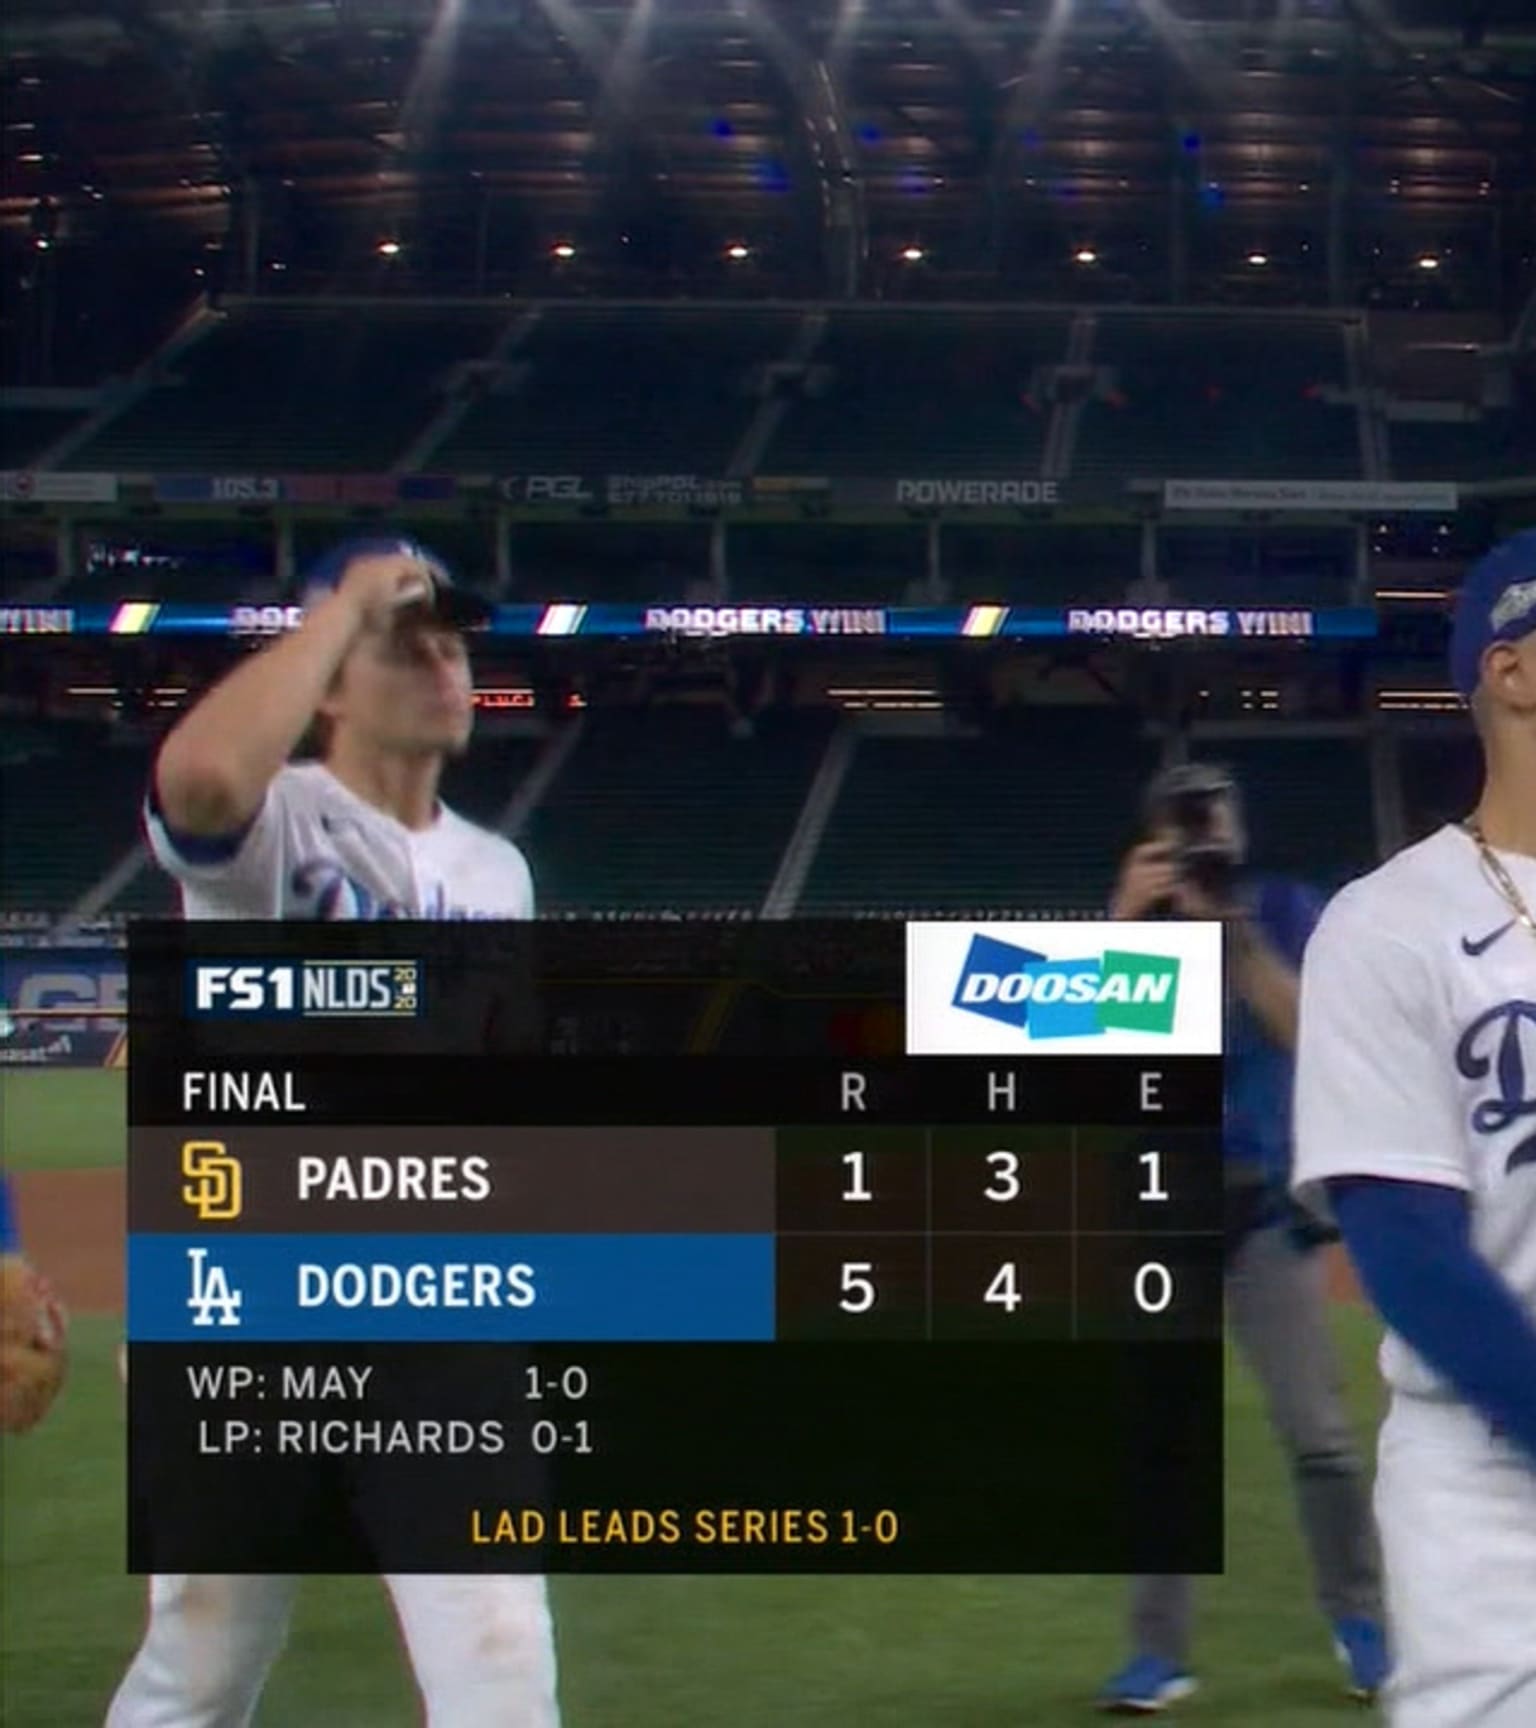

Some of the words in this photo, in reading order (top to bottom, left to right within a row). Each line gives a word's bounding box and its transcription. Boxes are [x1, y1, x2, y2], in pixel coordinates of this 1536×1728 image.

[896, 480, 1058, 503] POWERADE
[645, 608, 805, 634] DODGERS
[1068, 609, 1230, 635] DODGERS
